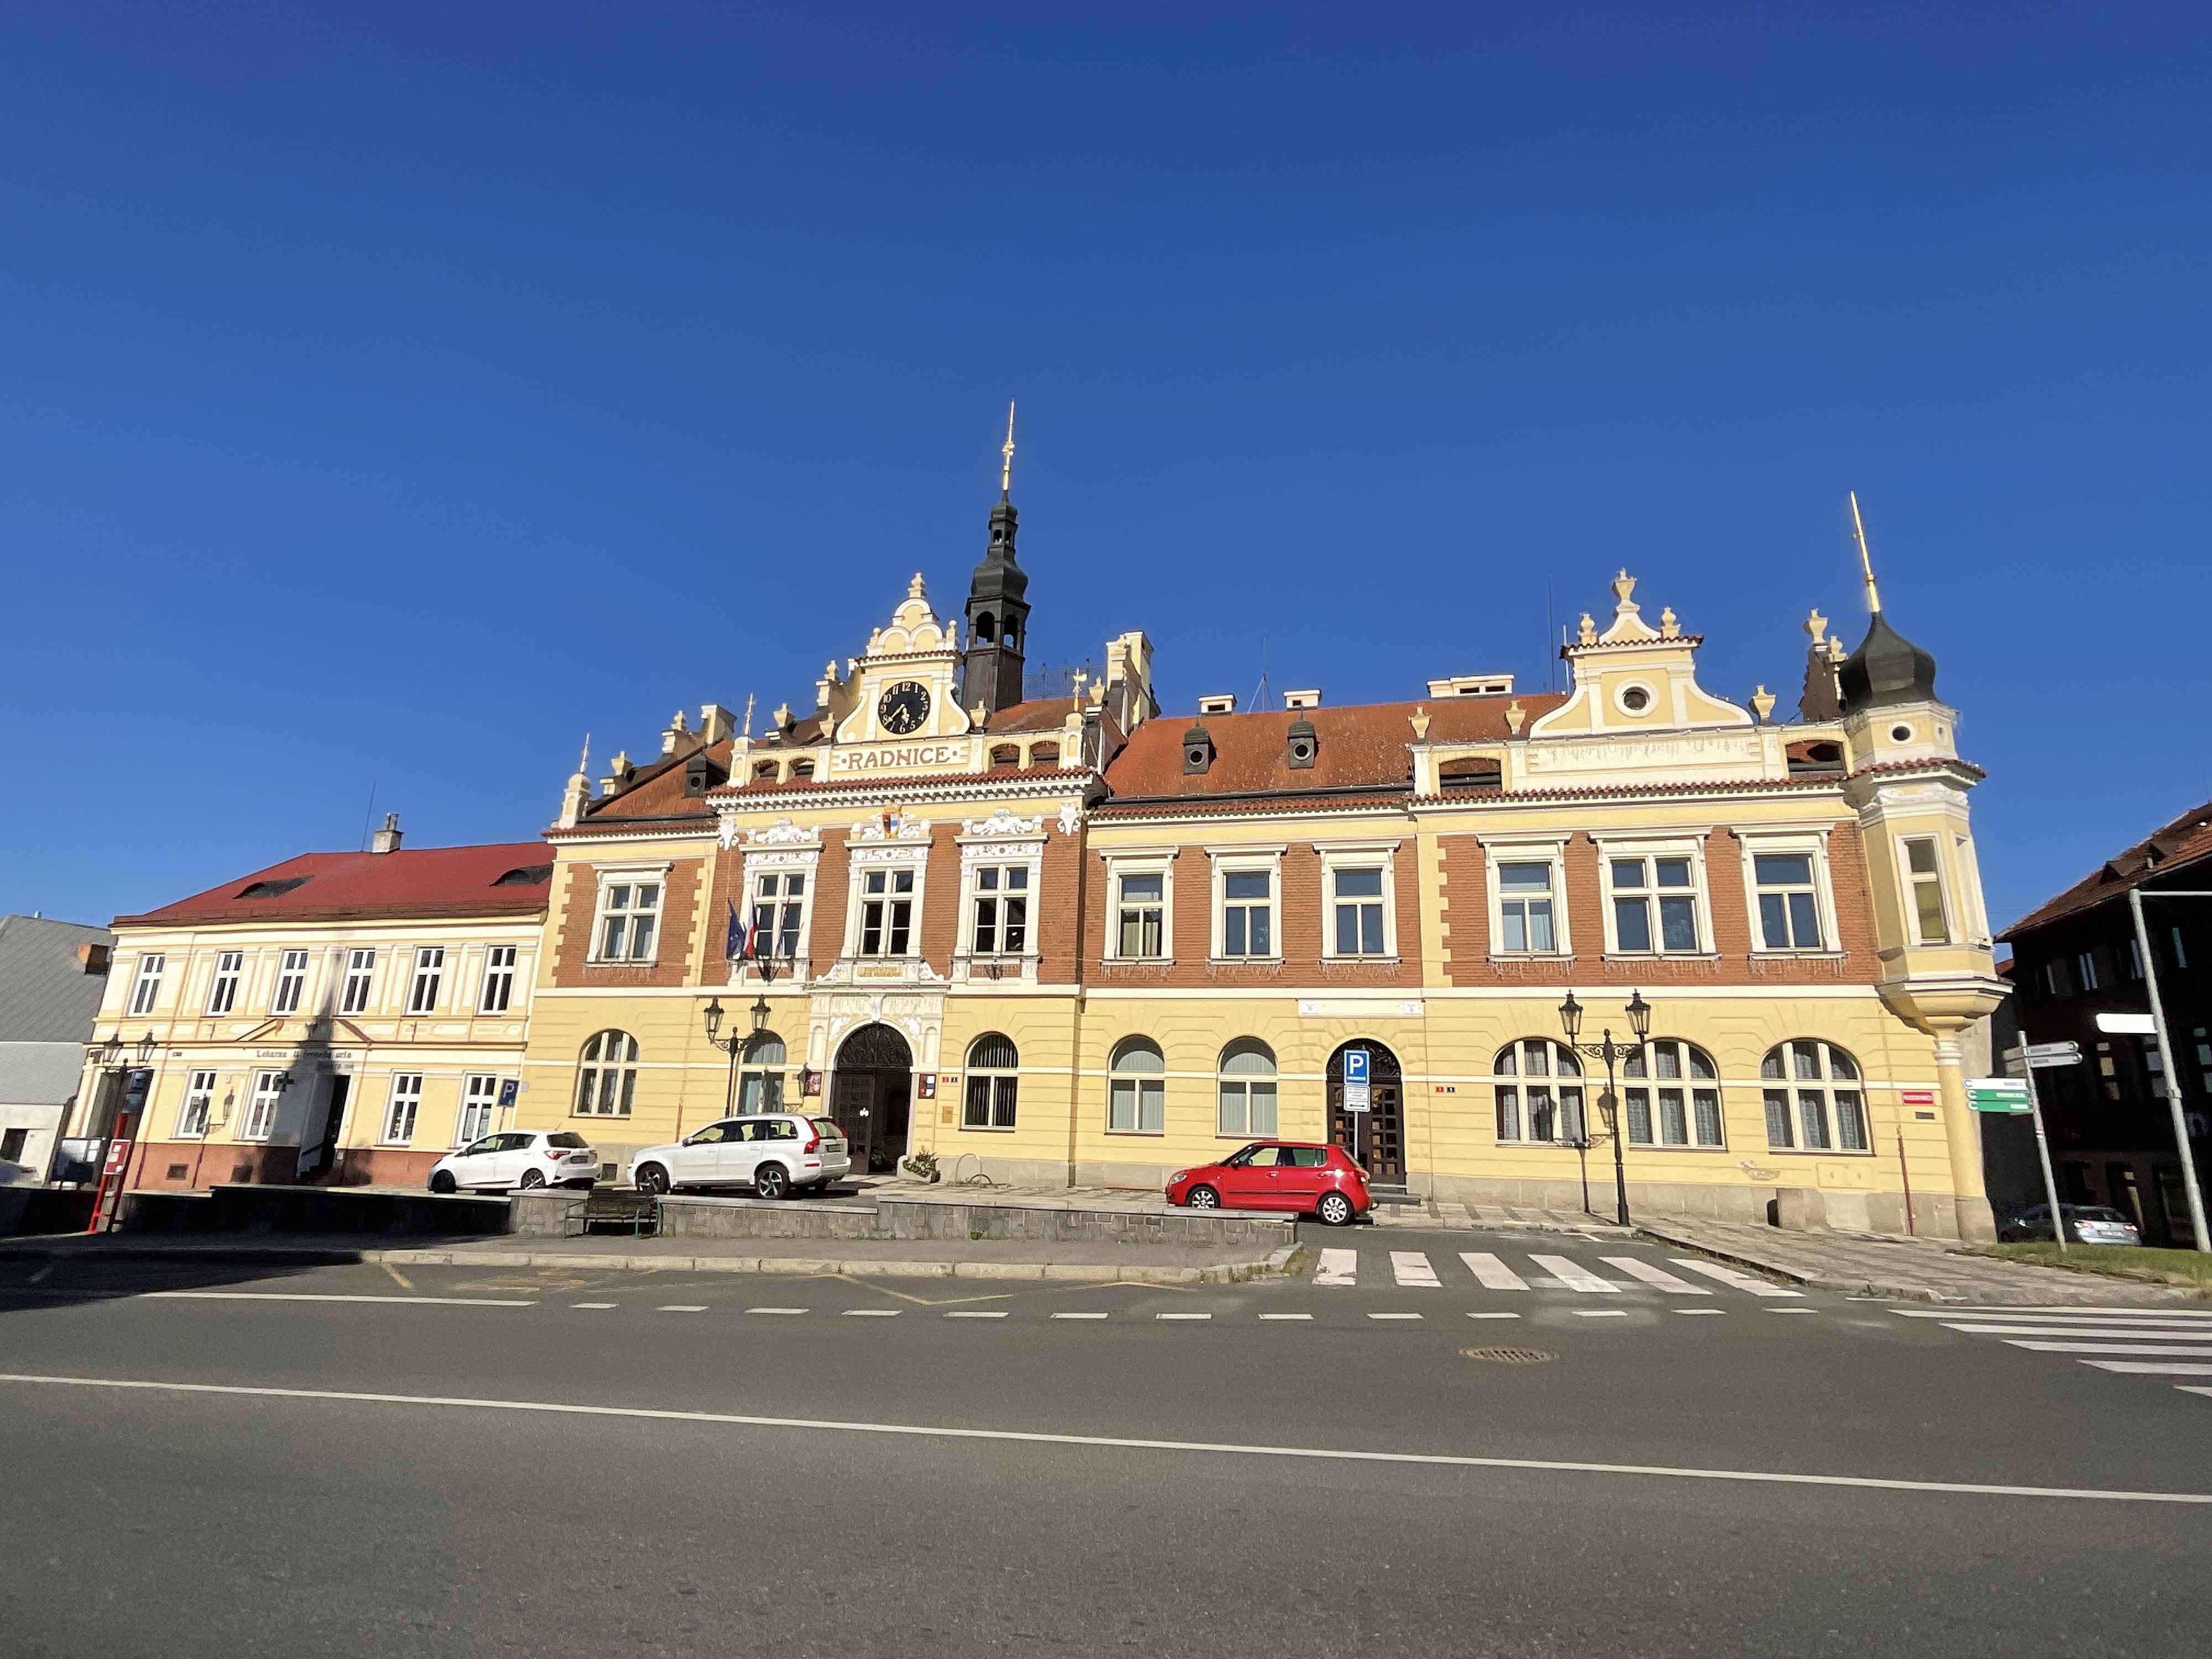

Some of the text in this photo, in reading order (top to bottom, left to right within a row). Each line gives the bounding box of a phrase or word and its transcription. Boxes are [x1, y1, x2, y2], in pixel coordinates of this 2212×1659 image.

[892, 685, 899, 695] 11
[902, 682, 911, 692] 12
[914, 684, 919, 693] 1
[883, 693, 892, 703] 10
[920, 691, 927, 701] 2
[880, 704, 887, 713] 9
[922, 701, 928, 711] 3
[918, 712, 925, 721] 4
[889, 721, 896, 732] 7
[899, 723, 906, 733] 6
[910, 720, 916, 730] 5
[848, 747, 951, 770] RADNICE
[1350, 1055, 1364, 1074] P
[503, 1083, 514, 1098] P
